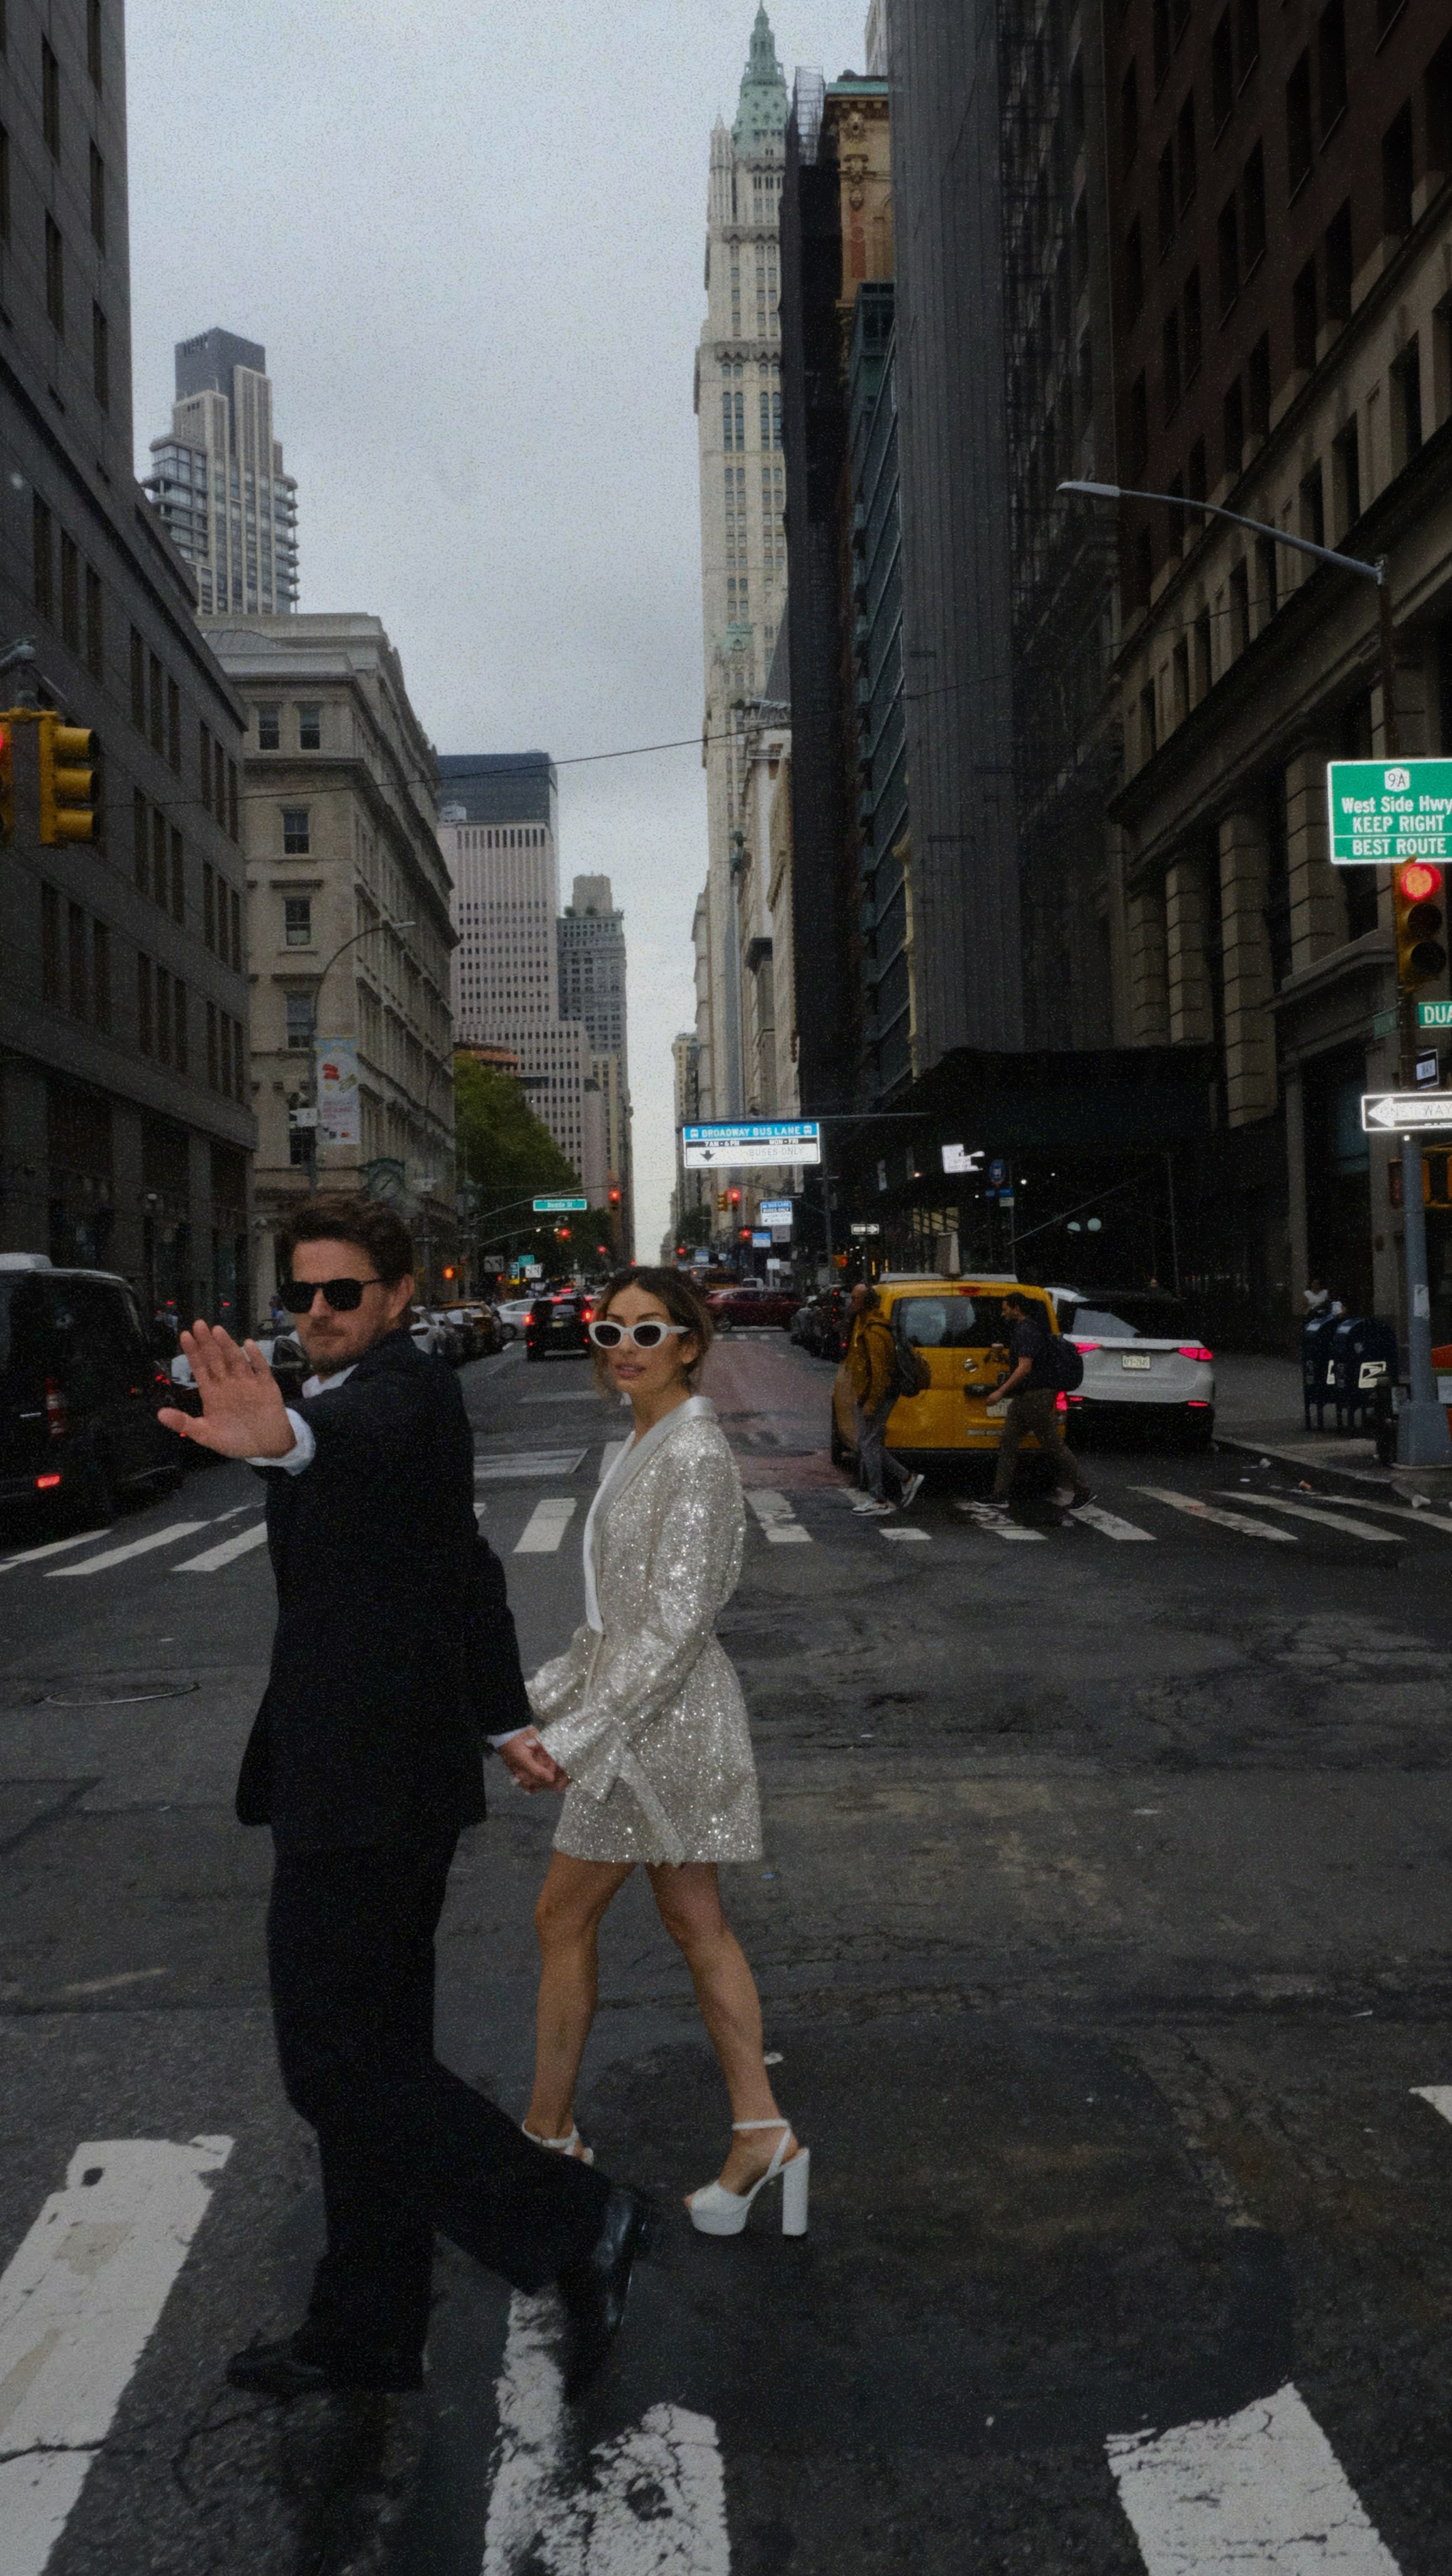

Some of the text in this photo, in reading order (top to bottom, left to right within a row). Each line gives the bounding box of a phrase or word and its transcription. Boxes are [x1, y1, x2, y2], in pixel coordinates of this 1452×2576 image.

[1388, 773, 1406, 788] 9A
[1341, 795, 1452, 815] West Side Hwy
[1353, 815, 1445, 833] KEEP RIGHT
[1353, 838, 1447, 855] BEST ROUTE
[1379, 1102, 1452, 1118] ONE WAY
[701, 1126, 801, 1138] BROADWAY BUS LANE
[749, 1146, 803, 1157] BUSES ONLY
